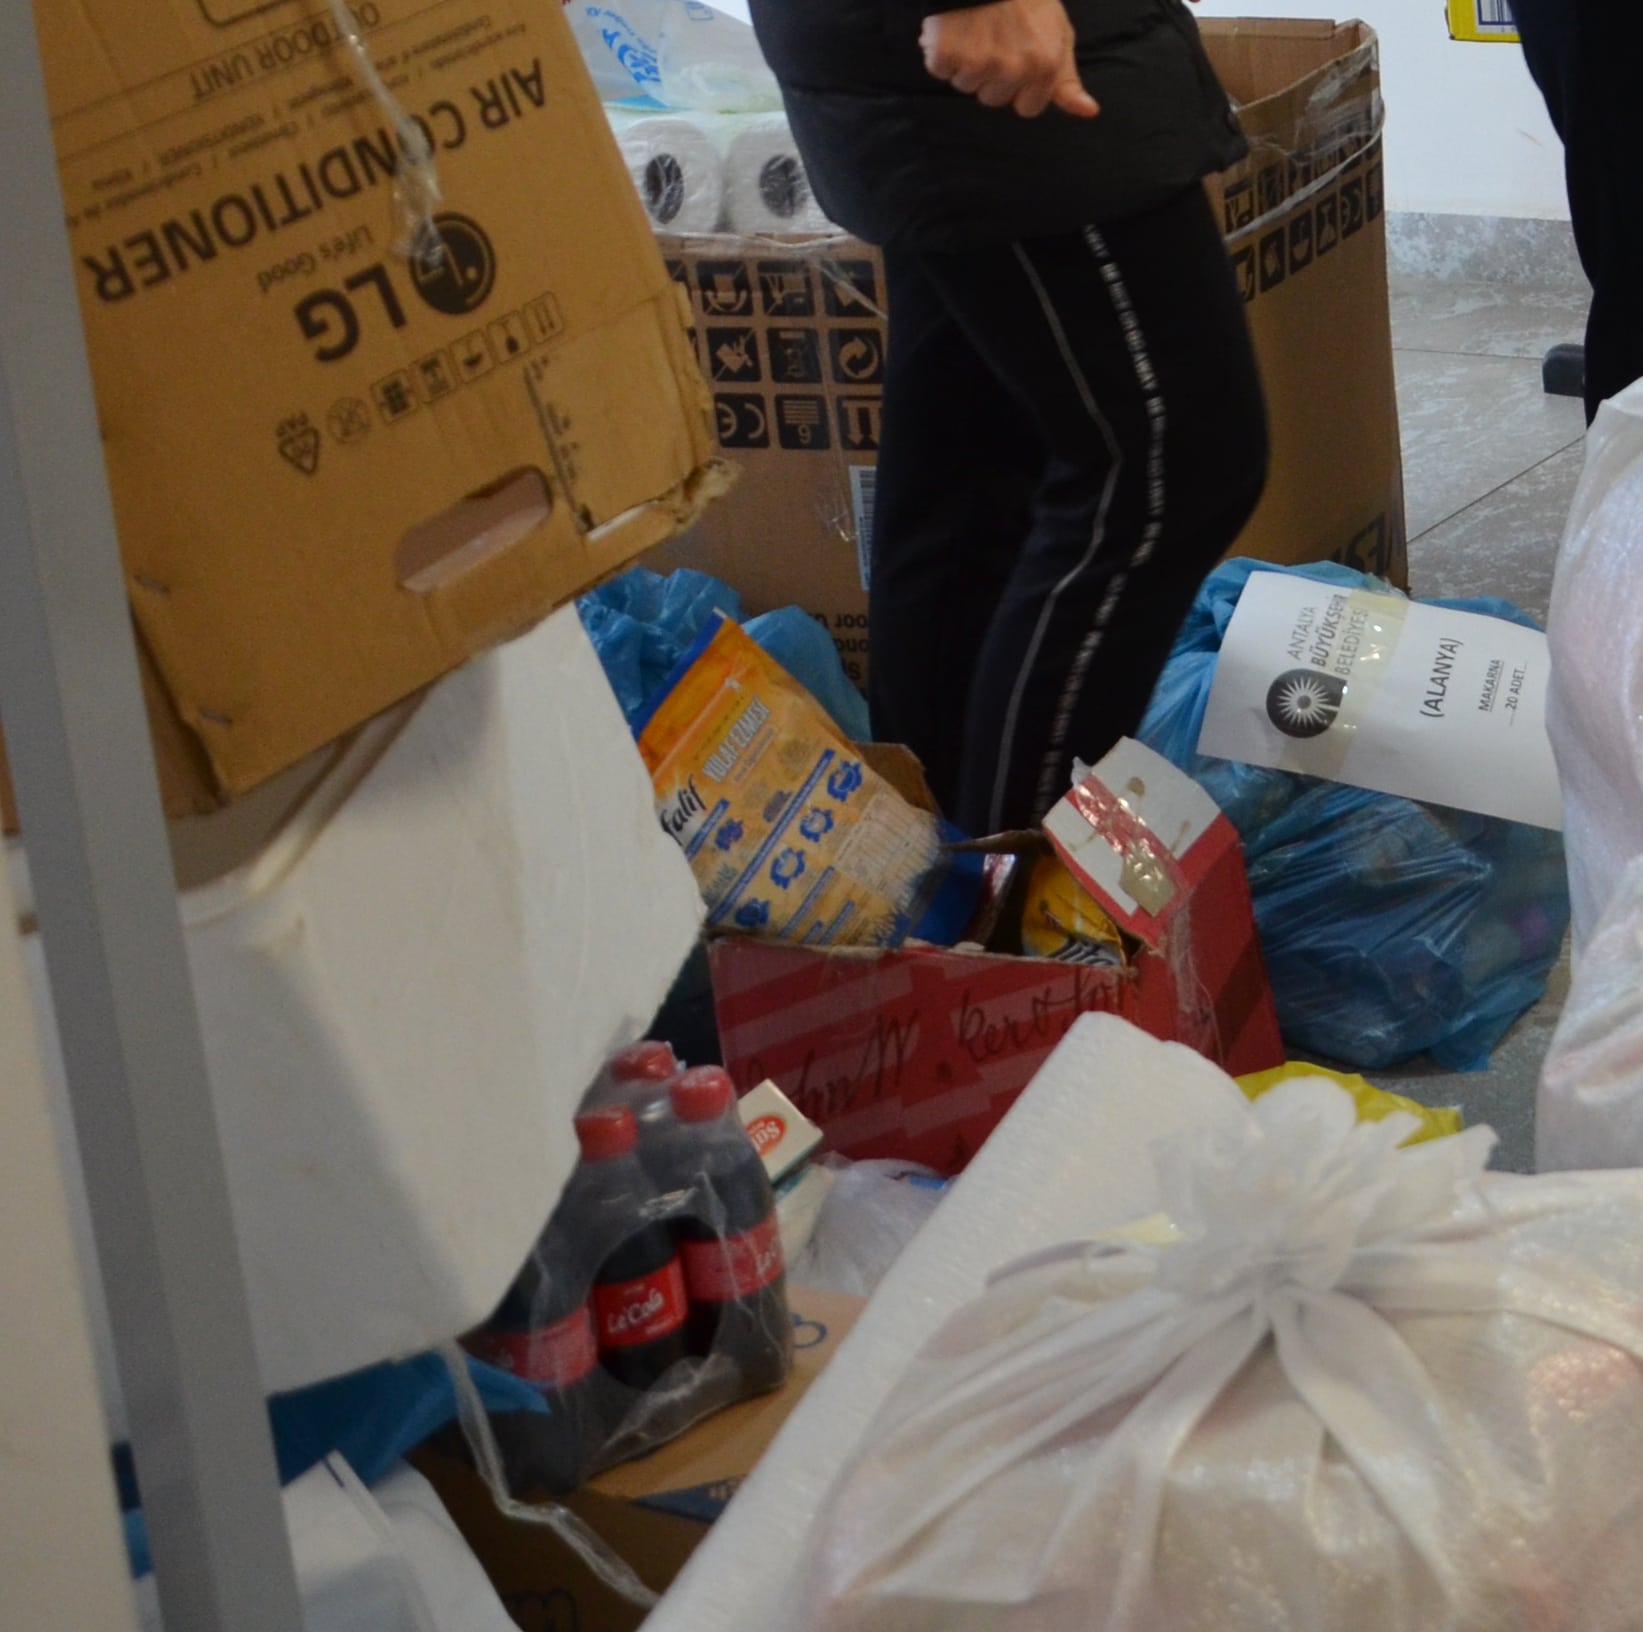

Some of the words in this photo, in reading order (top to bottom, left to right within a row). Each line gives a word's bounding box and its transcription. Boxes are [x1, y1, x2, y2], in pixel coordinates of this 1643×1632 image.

[190, 54, 257, 101] UNIT
[468, 57, 547, 132] AIR
[81, 98, 468, 305] CONDITIONER
[257, 249, 317, 295] Good
[294, 262, 407, 362] LG
[1287, 605, 1316, 661] ANTALYA
[1419, 637, 1465, 718] (ALANYA)
[1477, 658, 1503, 712] MAKARNA
